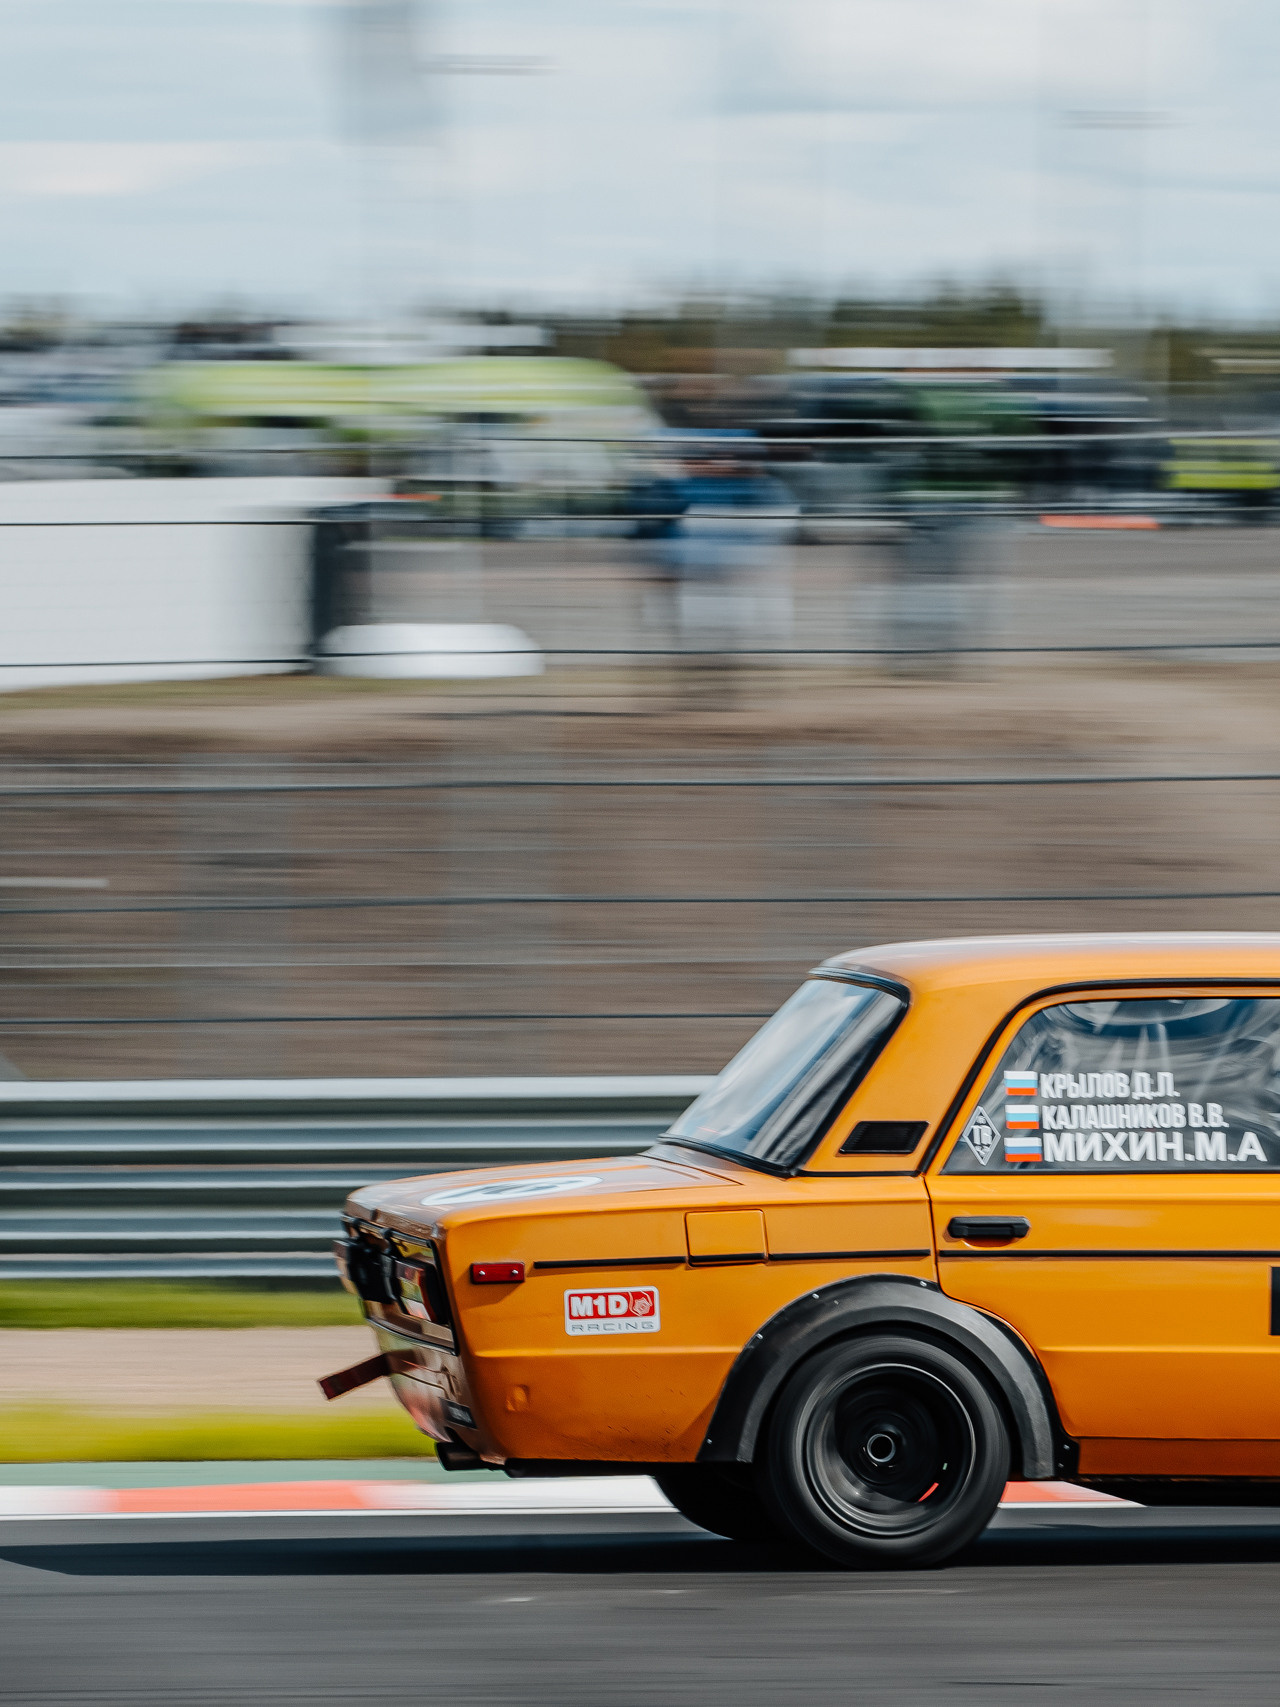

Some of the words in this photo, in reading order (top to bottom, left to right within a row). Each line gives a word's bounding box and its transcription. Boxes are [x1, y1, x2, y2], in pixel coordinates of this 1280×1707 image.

[1040, 1072, 1130, 1098] КРЫЛОВ
[1042, 1103, 1186, 1130] КАЛАШНИКОВ
[1188, 1102, 1230, 1128] В.В.
[570, 1294, 629, 1318] M1D
[571, 1321, 655, 1333] RACING
